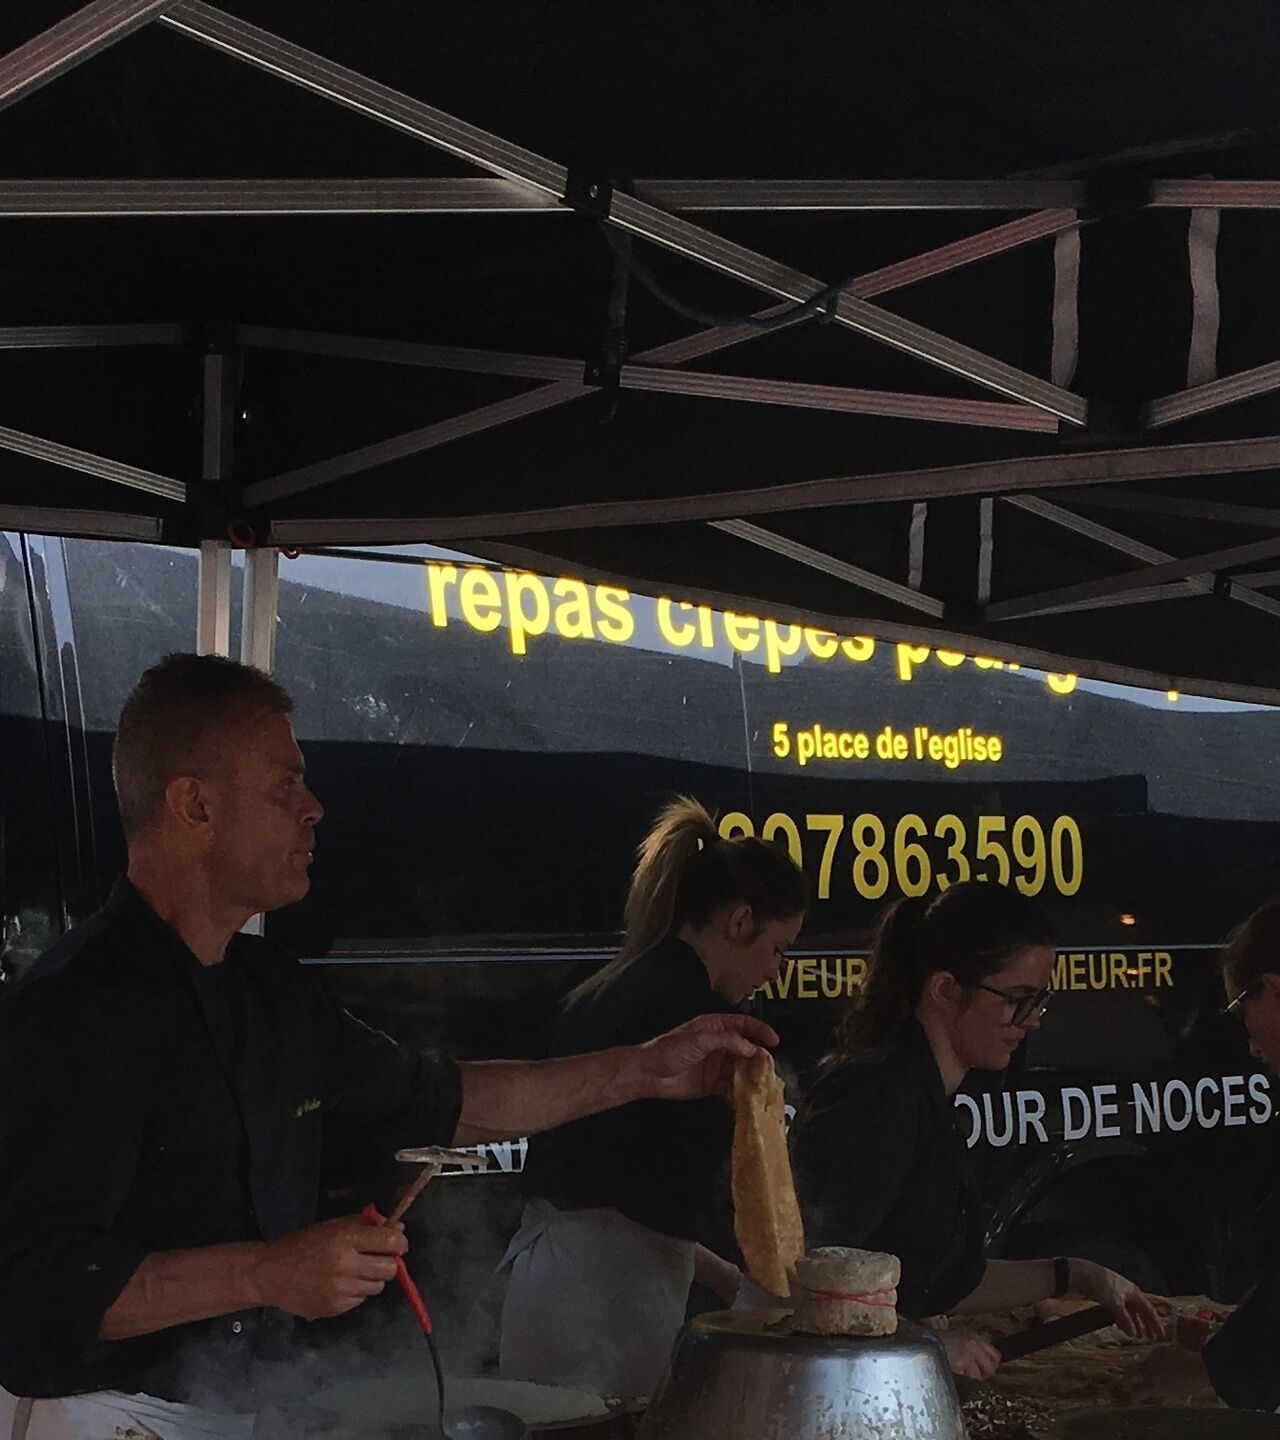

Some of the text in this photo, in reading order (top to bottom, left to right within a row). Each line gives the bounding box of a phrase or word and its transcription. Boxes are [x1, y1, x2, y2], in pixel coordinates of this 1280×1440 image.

[424, 560, 634, 655] repas
[772, 722, 1003, 769] 5 place de l'eglise
[1060, 1085, 1120, 1140] DE
